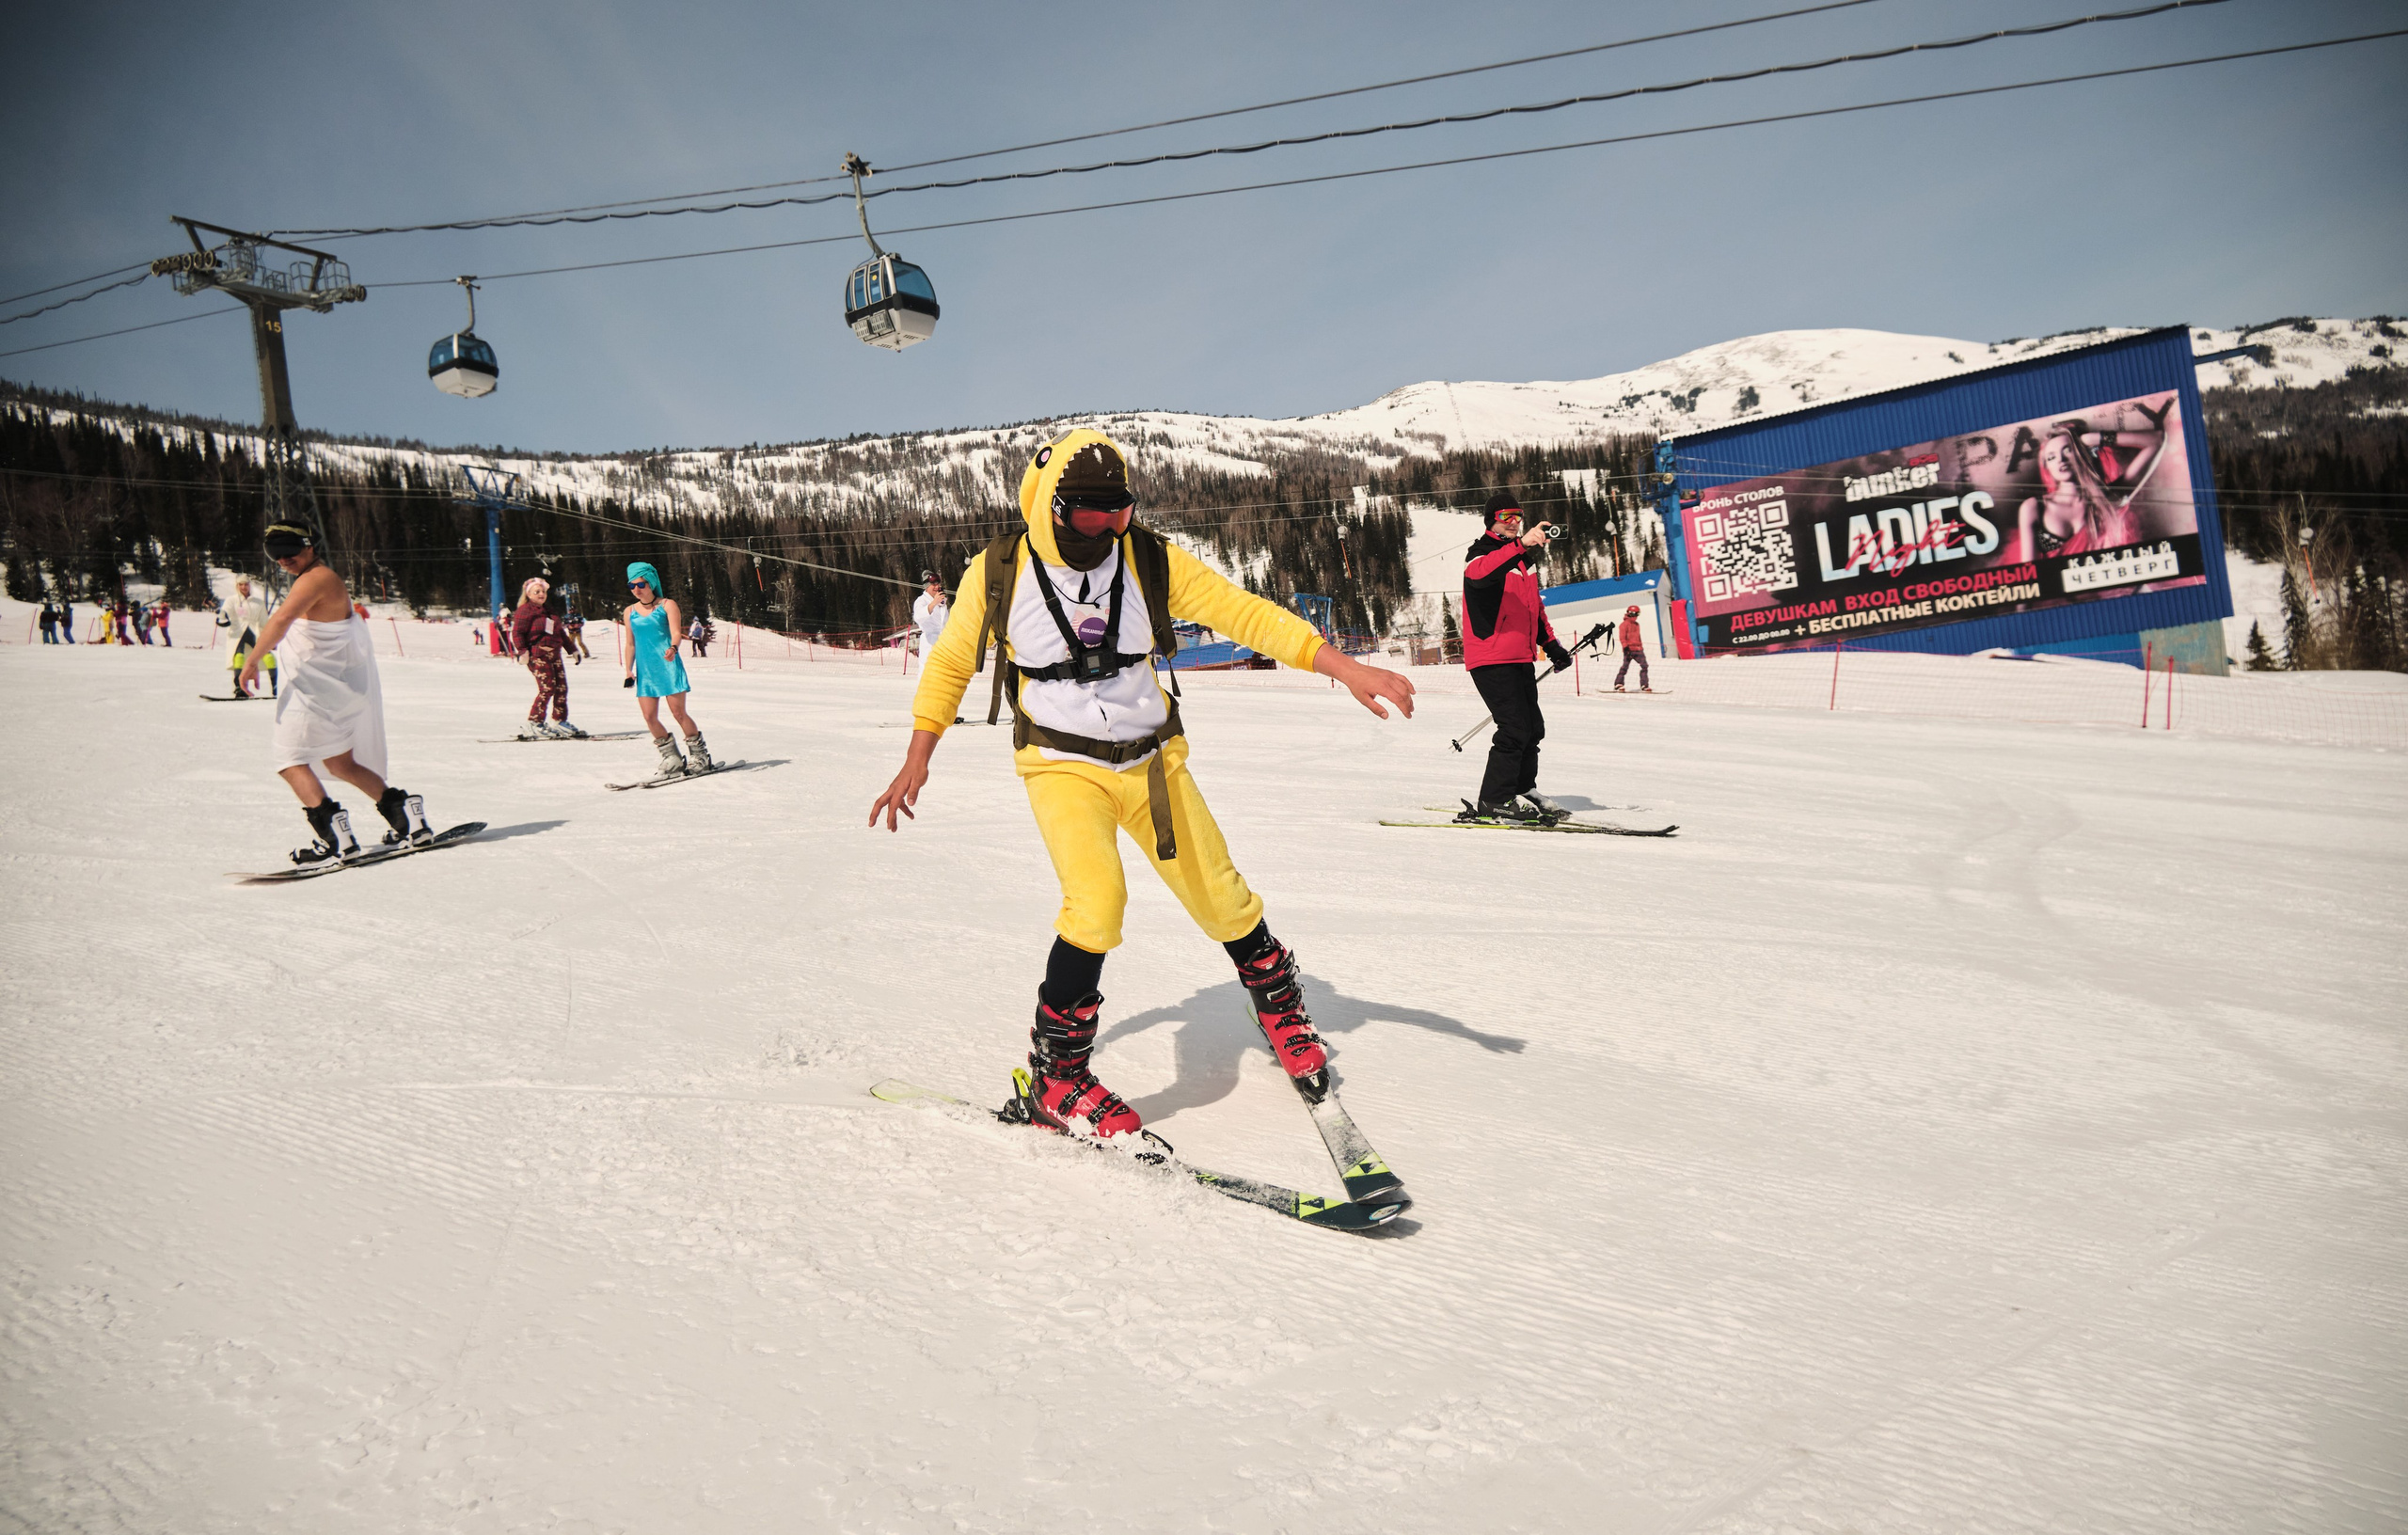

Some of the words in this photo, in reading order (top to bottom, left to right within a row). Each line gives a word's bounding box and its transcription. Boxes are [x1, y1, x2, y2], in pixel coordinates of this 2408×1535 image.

[265, 320, 282, 333] 15
[1734, 485, 1784, 504] СТОЛОВ
[1814, 491, 2000, 582] LADIES
[1845, 518, 1967, 578] Night
[2067, 540, 2172, 568] КАЖДЫЙ
[2072, 559, 2172, 583] ЧЕТВЕРГ
[1731, 599, 1837, 633] ДЕВУШКАМ
[1845, 588, 1901, 611] ВХОД
[1903, 562, 2038, 601] СВОБОДНЫЙ
[1809, 601, 1934, 634] БЕСПЛАТНЫЕ
[1935, 582, 2041, 613] КОКТЕЙЛИ
[1738, 634, 1758, 643] 22.00
[1758, 632, 1769, 641] ДО
[1769, 628, 1791, 638] 00.00
